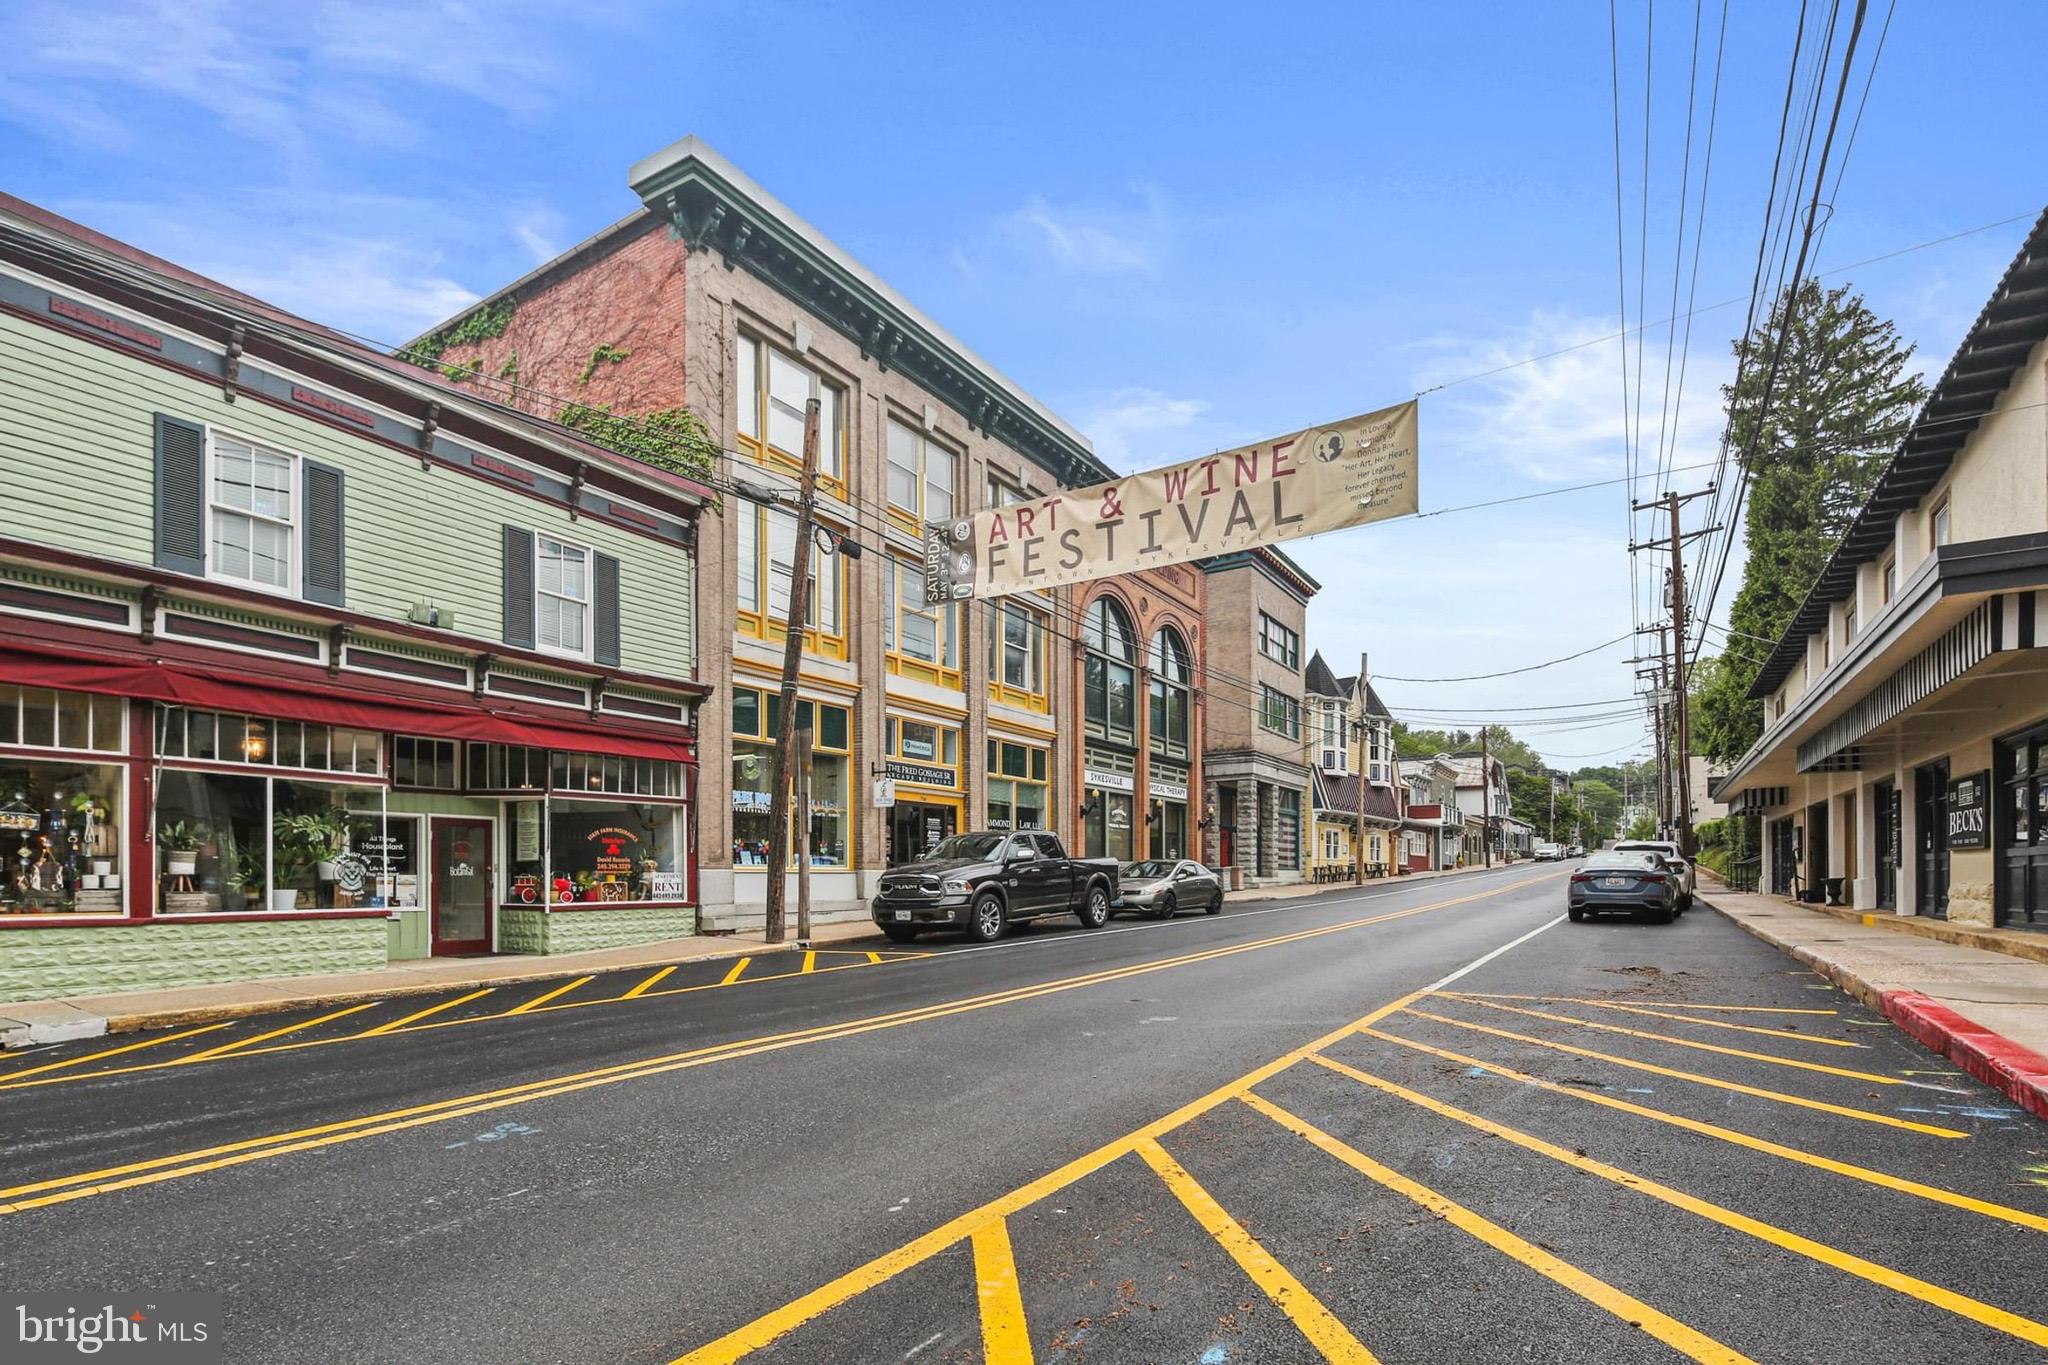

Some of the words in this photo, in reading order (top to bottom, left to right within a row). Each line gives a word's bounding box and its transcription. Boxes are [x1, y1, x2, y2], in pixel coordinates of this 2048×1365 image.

[1368, 421, 1393, 434] Loving
[1388, 430, 1396, 440] of
[1357, 448, 1380, 458] Donna
[1374, 455, 1388, 463] Her
[1388, 448, 1411, 459] Heart,
[1357, 470, 1371, 480] Her
[1372, 463, 1396, 475] Legacy
[989, 498, 1062, 544] ART
[1100, 486, 1125, 519] &
[1164, 440, 1297, 503] WINE
[1344, 481, 1371, 493] forever
[1375, 483, 1403, 496] beyond
[988, 480, 1304, 584] FESTIVAL
[1135, 524, 1304, 566] SYKESVILLE
[927, 528, 940, 602] SATURDAY
[940, 581, 948, 599] MAY
[887, 763, 902, 773] THE
[902, 765, 918, 776] FRED
[887, 773, 914, 781] ARCADE
[918, 776, 952, 785] BUILDING
[1090, 773, 1124, 785] SYKESVILLE
[1166, 787, 1186, 797] THERAPY
[1949, 807, 1984, 836] BECK'S
[654, 882, 681, 892] RENT
